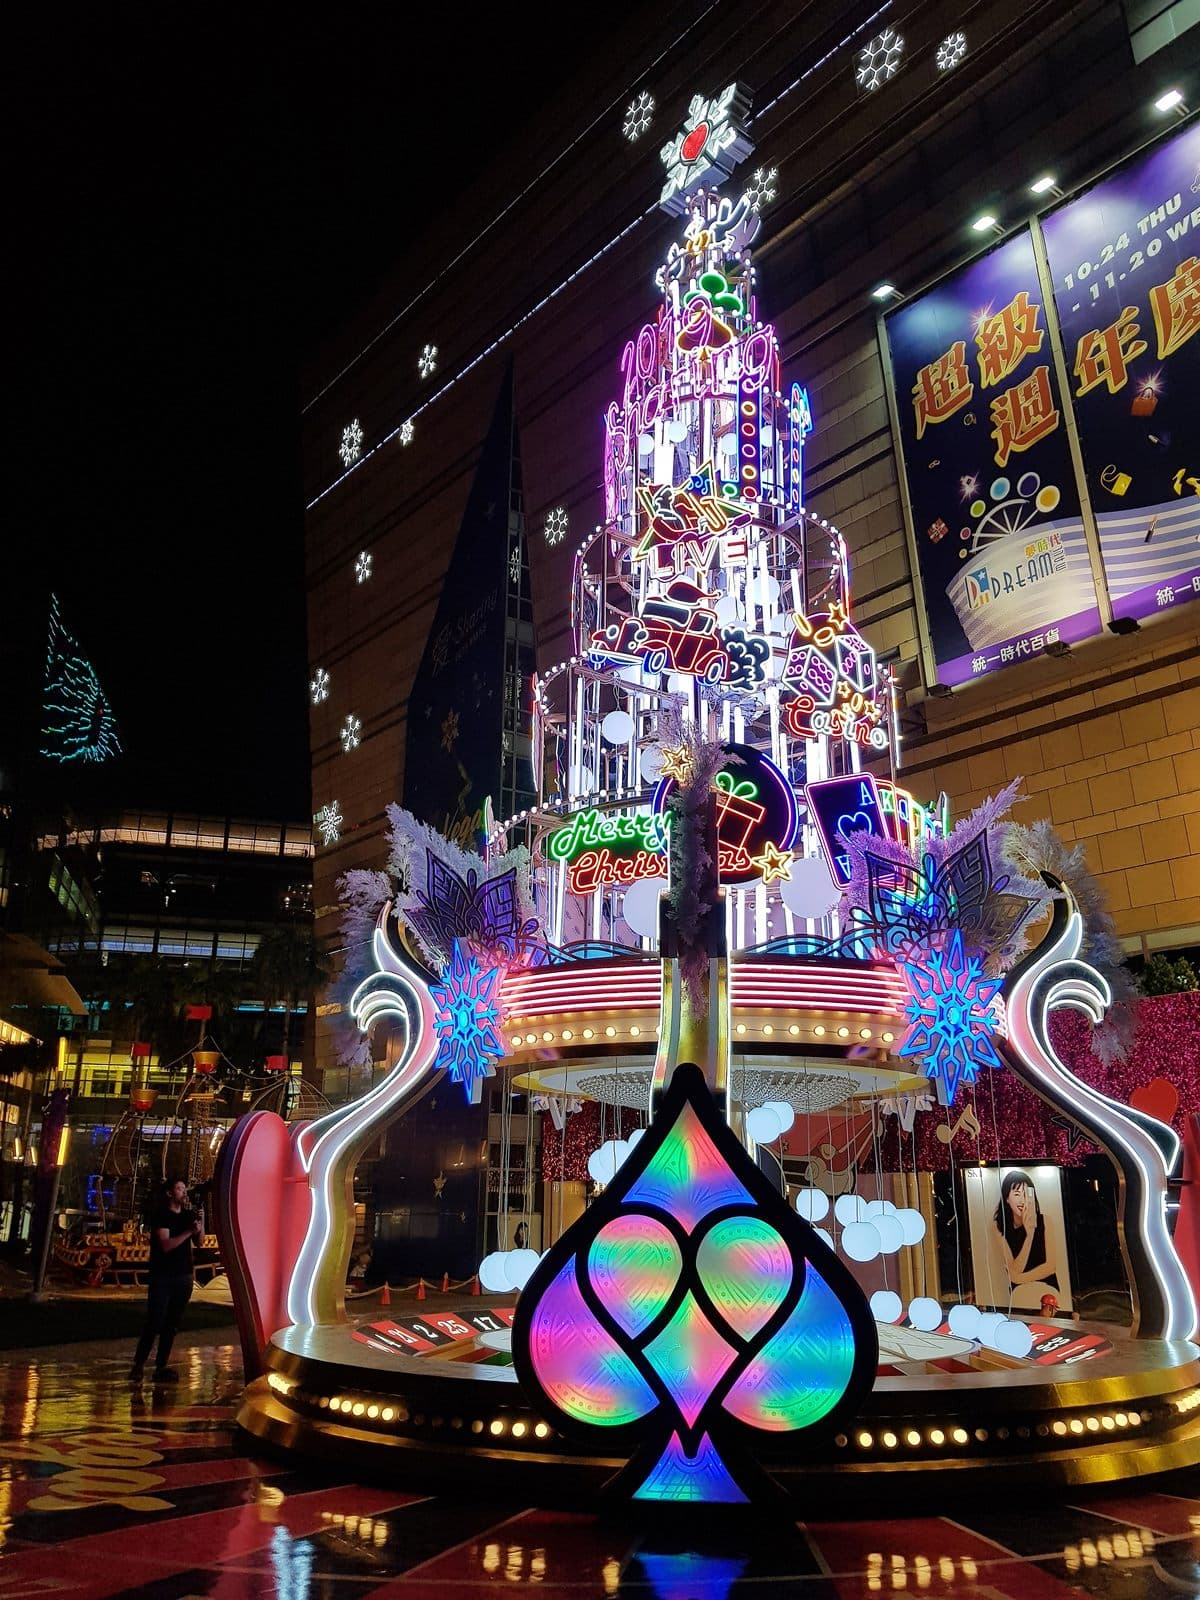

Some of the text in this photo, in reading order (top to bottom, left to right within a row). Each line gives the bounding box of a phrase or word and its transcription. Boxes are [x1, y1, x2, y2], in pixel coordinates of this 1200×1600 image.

[1064, 193, 1181, 290] 10.24 THU
[912, 291, 1044, 440] 超級
[648, 537, 747, 578] LIVE
[991, 552, 1054, 599] DREAM
[786, 694, 889, 750] Casino
[860, 782, 875, 806] A
[551, 808, 673, 860] Merry
[413, 1324, 439, 1338] 2
[437, 1320, 469, 1335] 25
[473, 1316, 501, 1331] 17
